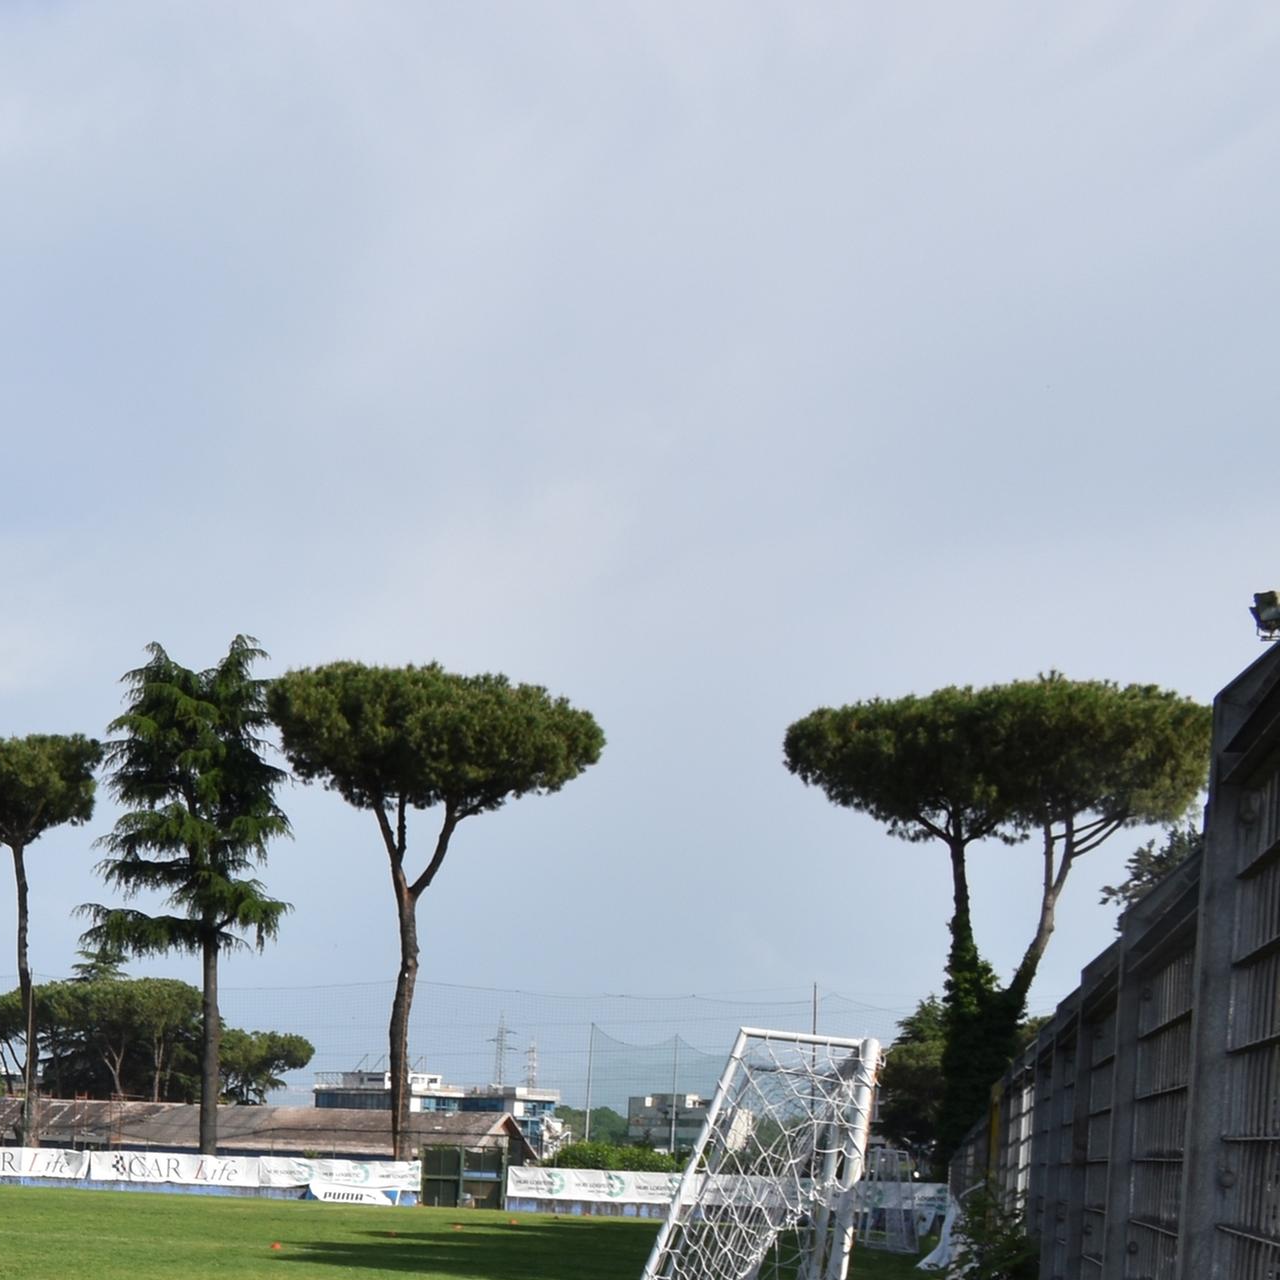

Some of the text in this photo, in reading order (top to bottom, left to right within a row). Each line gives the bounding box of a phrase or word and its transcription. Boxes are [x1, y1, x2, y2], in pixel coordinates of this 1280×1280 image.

[27, 1151, 72, 1175] Life
[127, 1155, 238, 1182] CAR Life
[322, 1191, 365, 1202] PUMA
